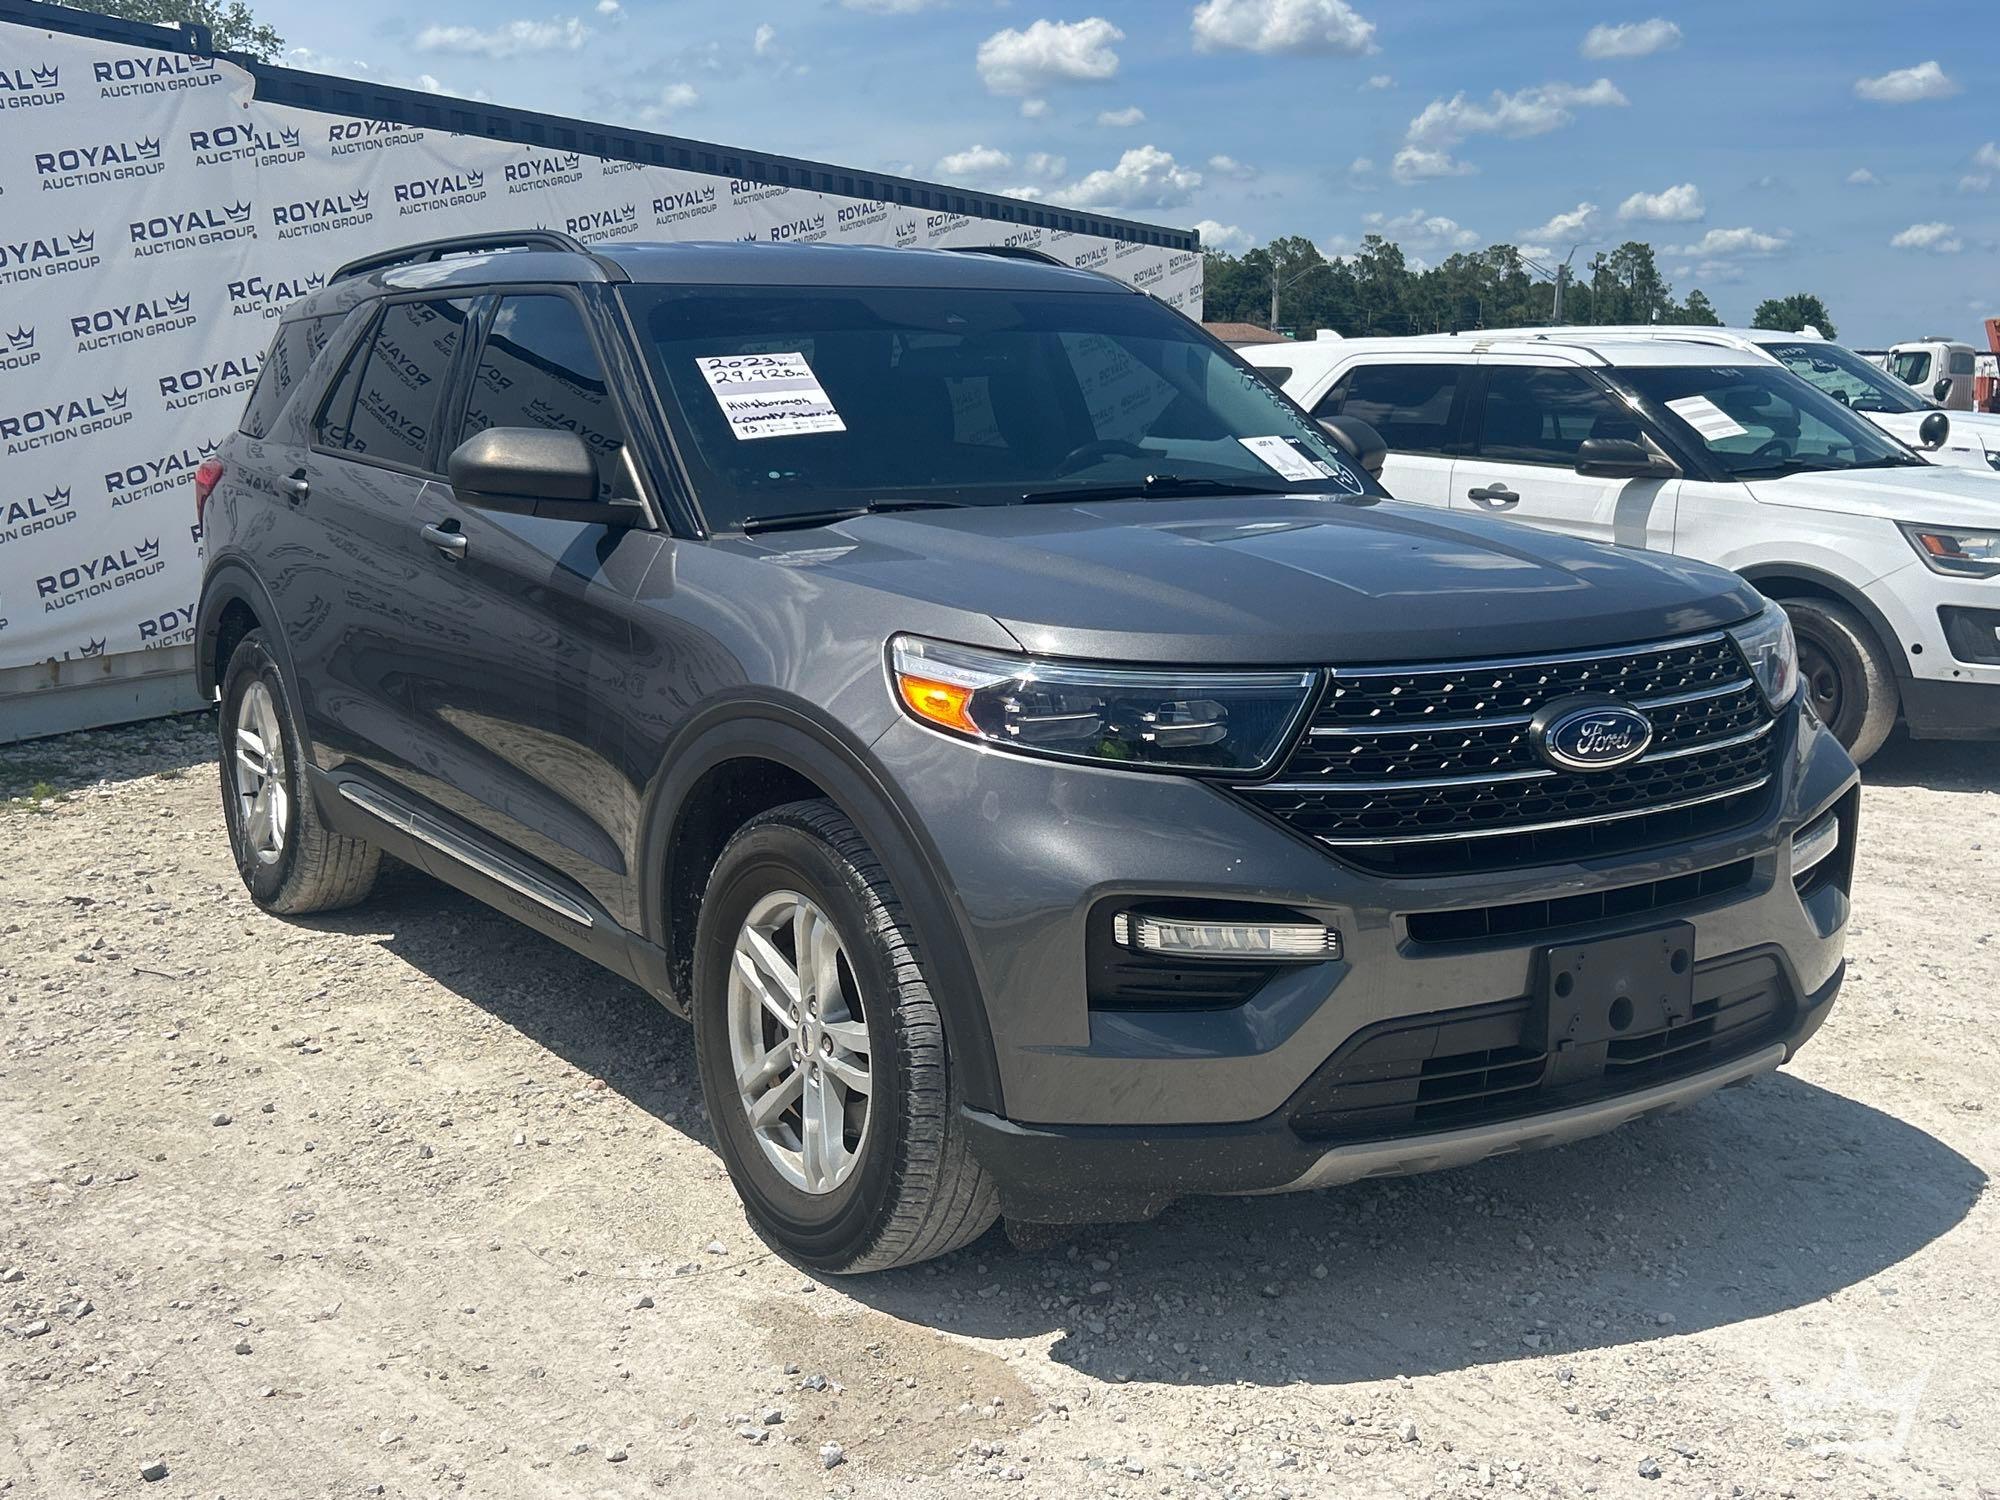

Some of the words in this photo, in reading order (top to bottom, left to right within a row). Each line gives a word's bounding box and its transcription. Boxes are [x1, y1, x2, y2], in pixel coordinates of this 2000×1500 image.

[93, 55, 189, 82] ROYAL
[100, 81, 166, 99] AUCTION
[168, 74, 222, 92] GROUP
[9, 92, 65, 109] GROUP
[331, 139, 383, 156] AUCTION
[385, 132, 424, 147] GROUP
[35, 143, 137, 174] ROYAL
[261, 151, 305, 167] GROUP
[505, 156, 565, 182] ROYAL
[42, 171, 111, 191] AUCTION
[114, 162, 165, 180] GROUP
[394, 175, 467, 202] ROYAL
[508, 179, 550, 194] AUCTION
[551, 172, 583, 186] GROUP
[273, 196, 352, 225] ROYAL
[399, 198, 449, 217] AUCTION
[450, 191, 487, 206] GROUP
[653, 190, 703, 214] ROYAL
[733, 192, 764, 206] AUCTION
[837, 200, 876, 223] ROYAL
[130, 209, 225, 242] ROYAL
[277, 221, 330, 240] AUCTION
[332, 212, 373, 229] GROUP
[566, 209, 623, 235] ROYAL
[656, 210, 691, 226] AUCTION
[691, 203, 717, 217] GROUP
[134, 236, 196, 258] AUCTION
[198, 225, 255, 245] GROUP
[577, 229, 608, 245] UCTION
[610, 223, 639, 237] GROUP
[771, 218, 815, 242] ROYAL
[45, 256, 100, 275] GROUP
[1075, 249, 1102, 268] ROYAL
[1133, 267, 1156, 283] ROYAL
[71, 300, 168, 337] ROYAL
[78, 328, 144, 353] AUCTION
[146, 315, 197, 337] GROUP
[0, 353, 41, 370] ROUP
[159, 357, 258, 396] ROYAL
[166, 382, 231, 411] AUCTION
[0, 398, 105, 439] ROYAL
[7, 427, 77, 455] AUCTION
[81, 412, 133, 434] GROUP
[105, 450, 199, 493] ROYAL
[112, 476, 174, 508] AUCTION
[21, 511, 77, 537] GROUP
[36, 550, 138, 598] ROYAL
[45, 580, 112, 614] AUCTION
[115, 561, 165, 587] GROUP
[138, 603, 194, 641] ROY
[1576, 718, 1632, 755] Ford
